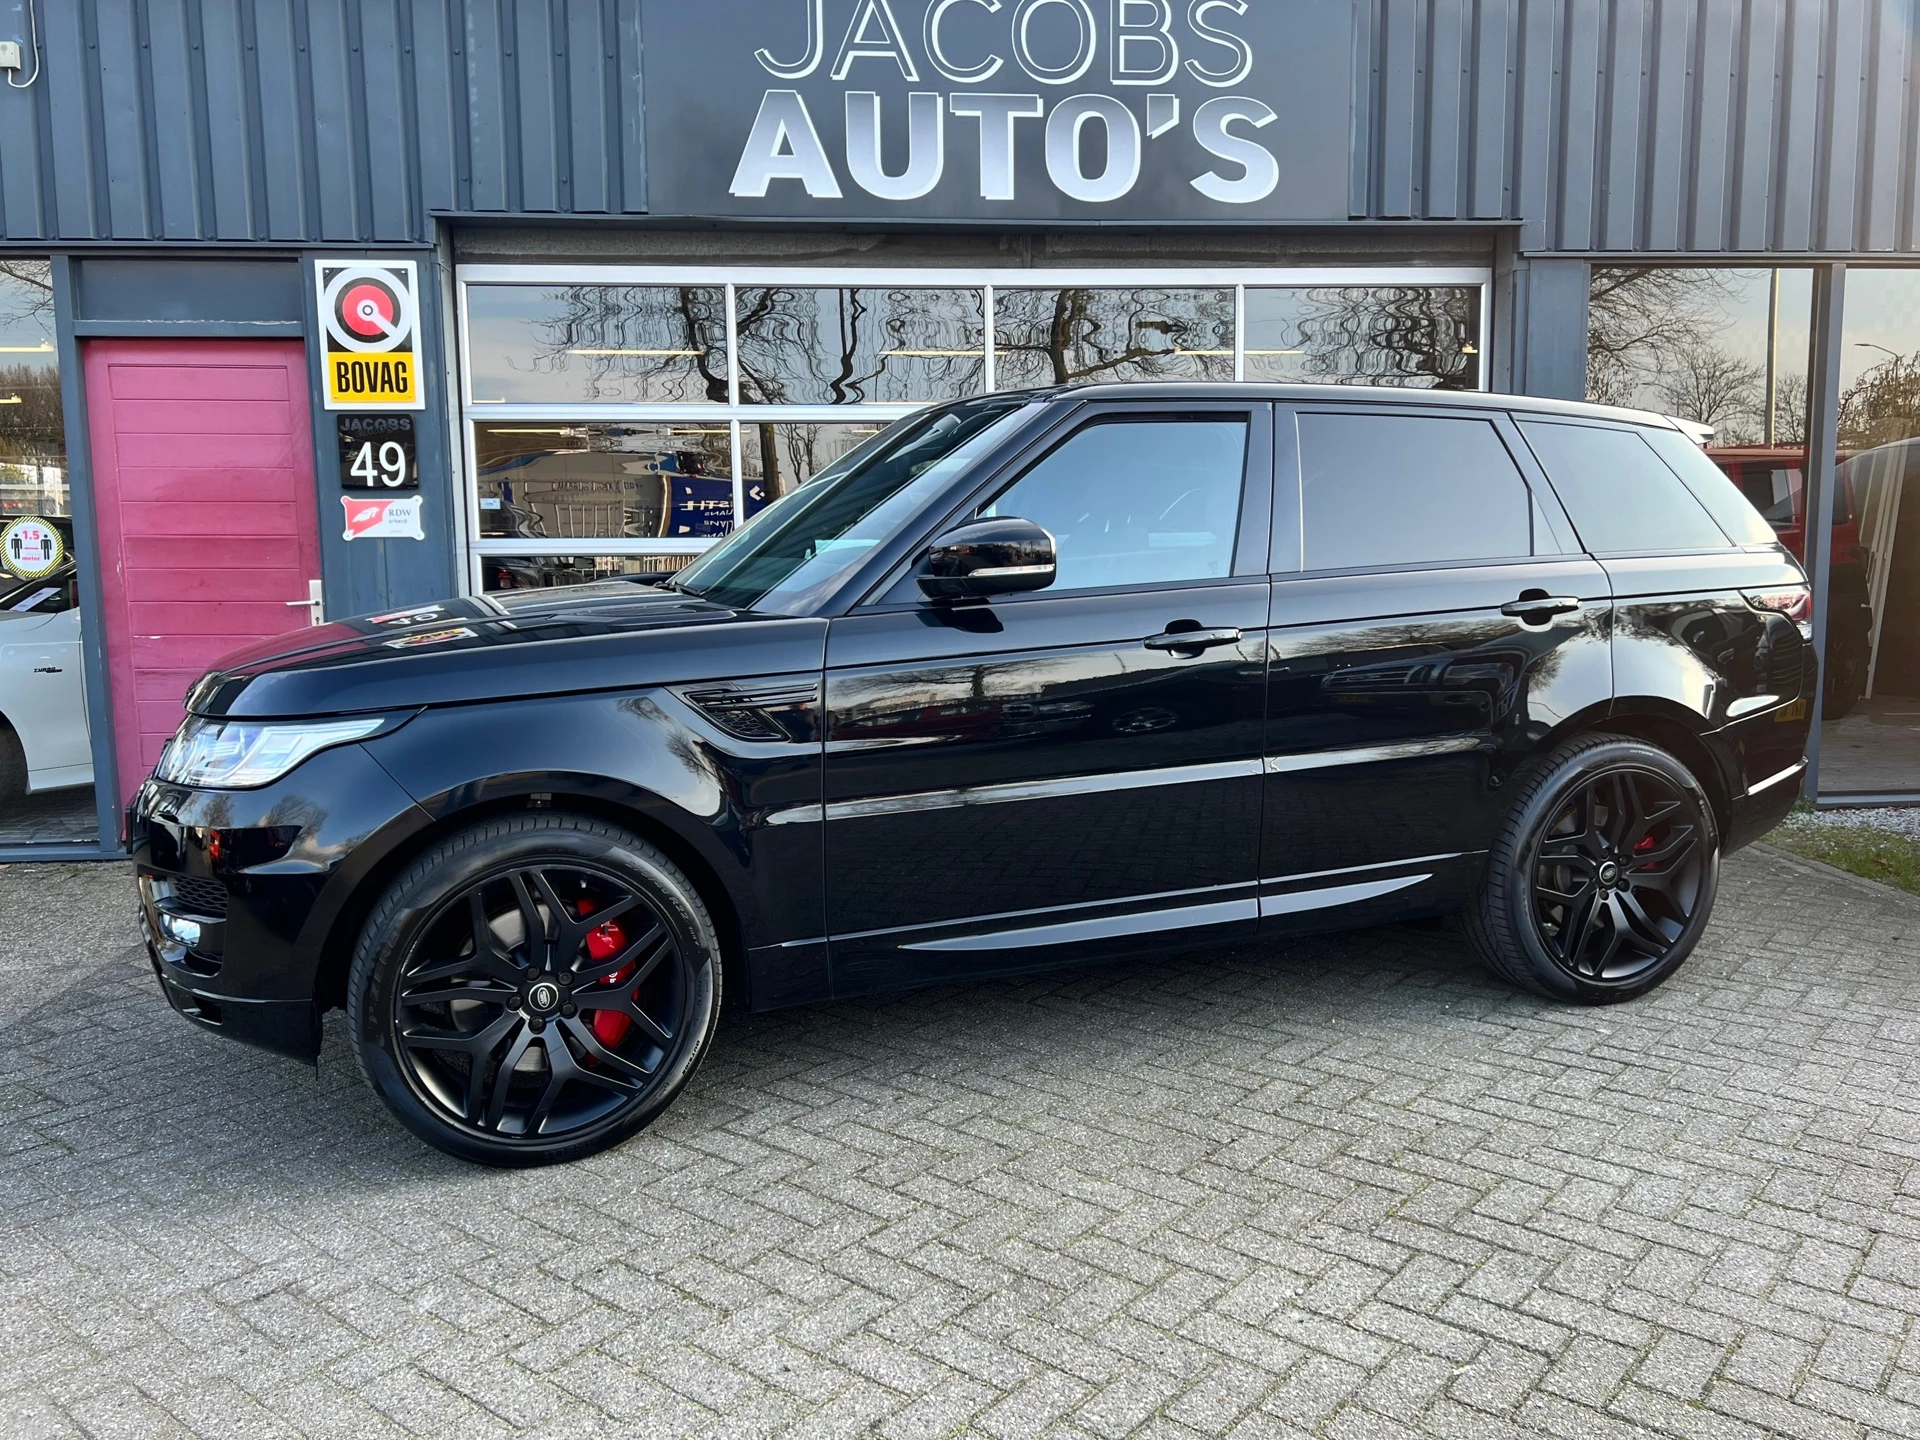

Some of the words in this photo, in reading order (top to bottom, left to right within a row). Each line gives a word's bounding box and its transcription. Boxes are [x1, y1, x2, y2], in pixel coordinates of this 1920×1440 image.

[754, 0, 1253, 88] JACOBS
[728, 89, 1280, 203] AUTO'S
[335, 360, 409, 394] BOVAG
[339, 417, 411, 431] JACOBS
[350, 441, 406, 488] 49
[388, 508, 412, 517] RDW
[22, 530, 40, 540] 1.5
